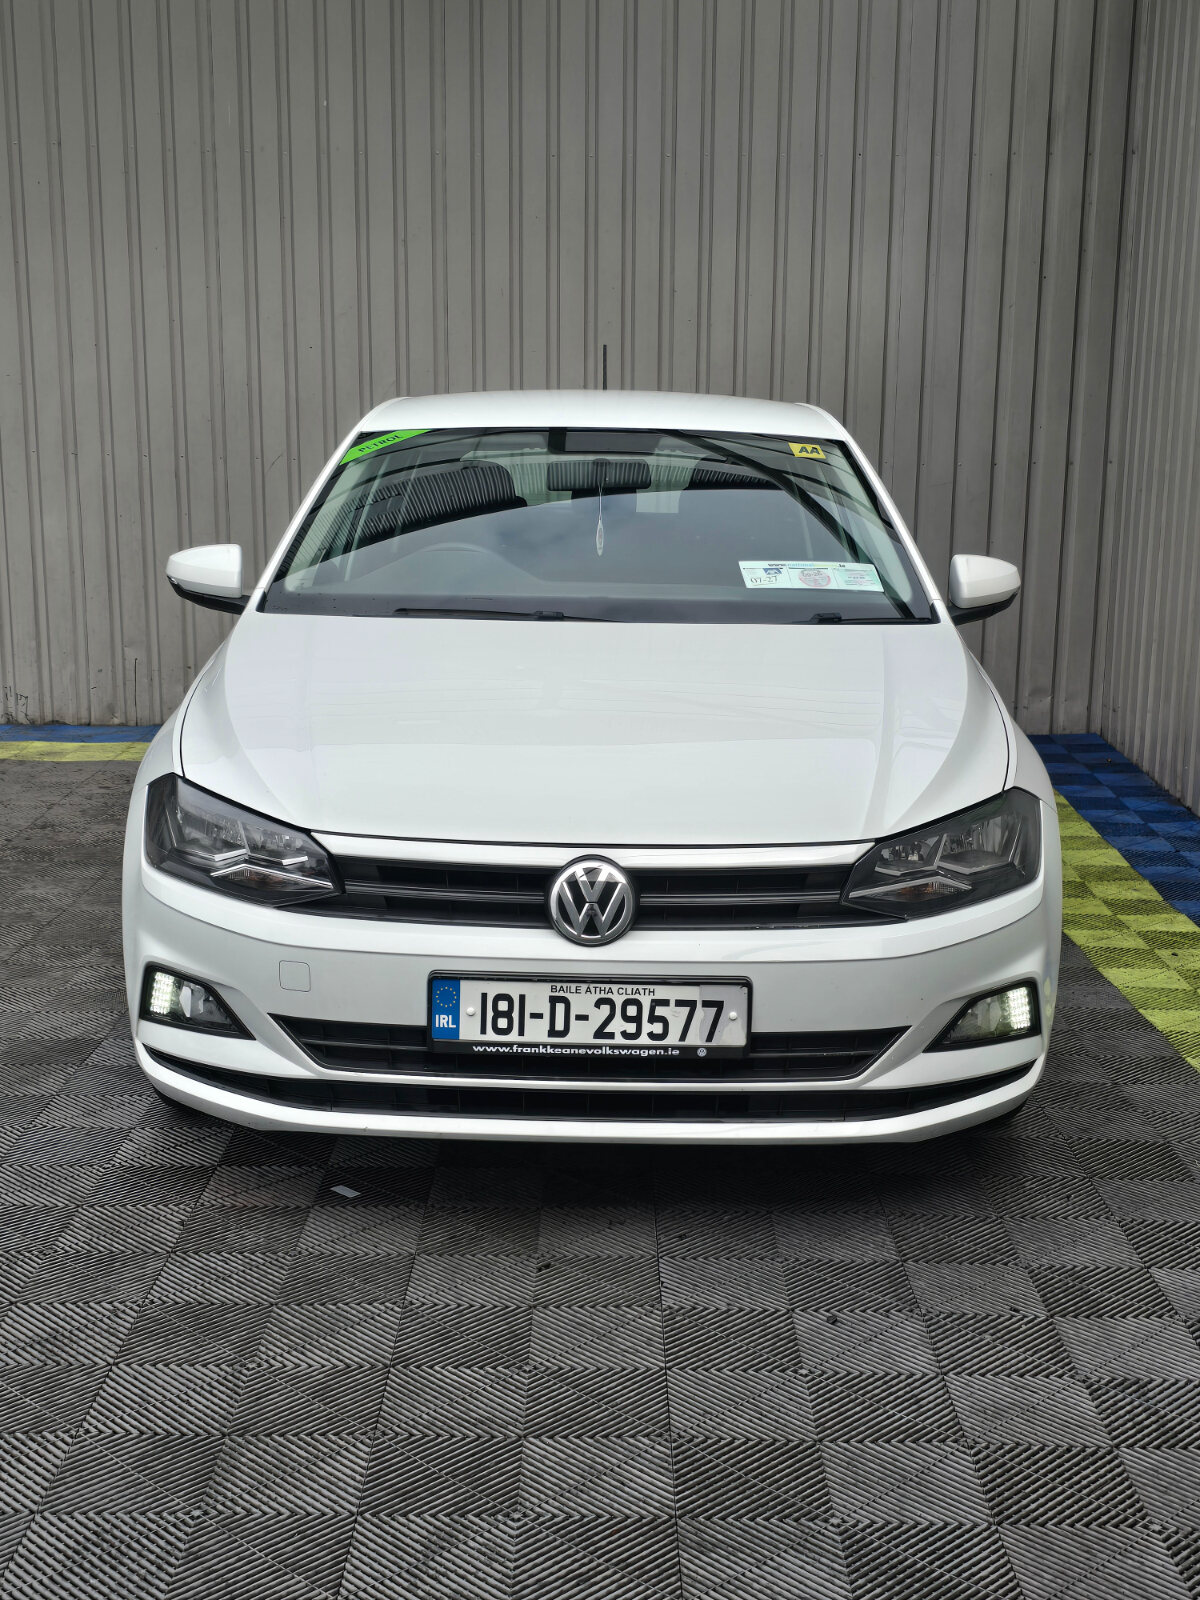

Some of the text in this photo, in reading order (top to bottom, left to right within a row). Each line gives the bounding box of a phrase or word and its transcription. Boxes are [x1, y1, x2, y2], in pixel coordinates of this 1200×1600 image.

[358, 434, 402, 452] PETROL
[799, 446, 820, 454] AA
[551, 861, 632, 944] VW
[550, 984, 655, 996] BAILE ÁTHA CLIATH
[435, 1014, 457, 1028] IRL
[480, 992, 725, 1043] 181-D-29577
[472, 1045, 680, 1057] www.frankkeanevolkswagen.ie
